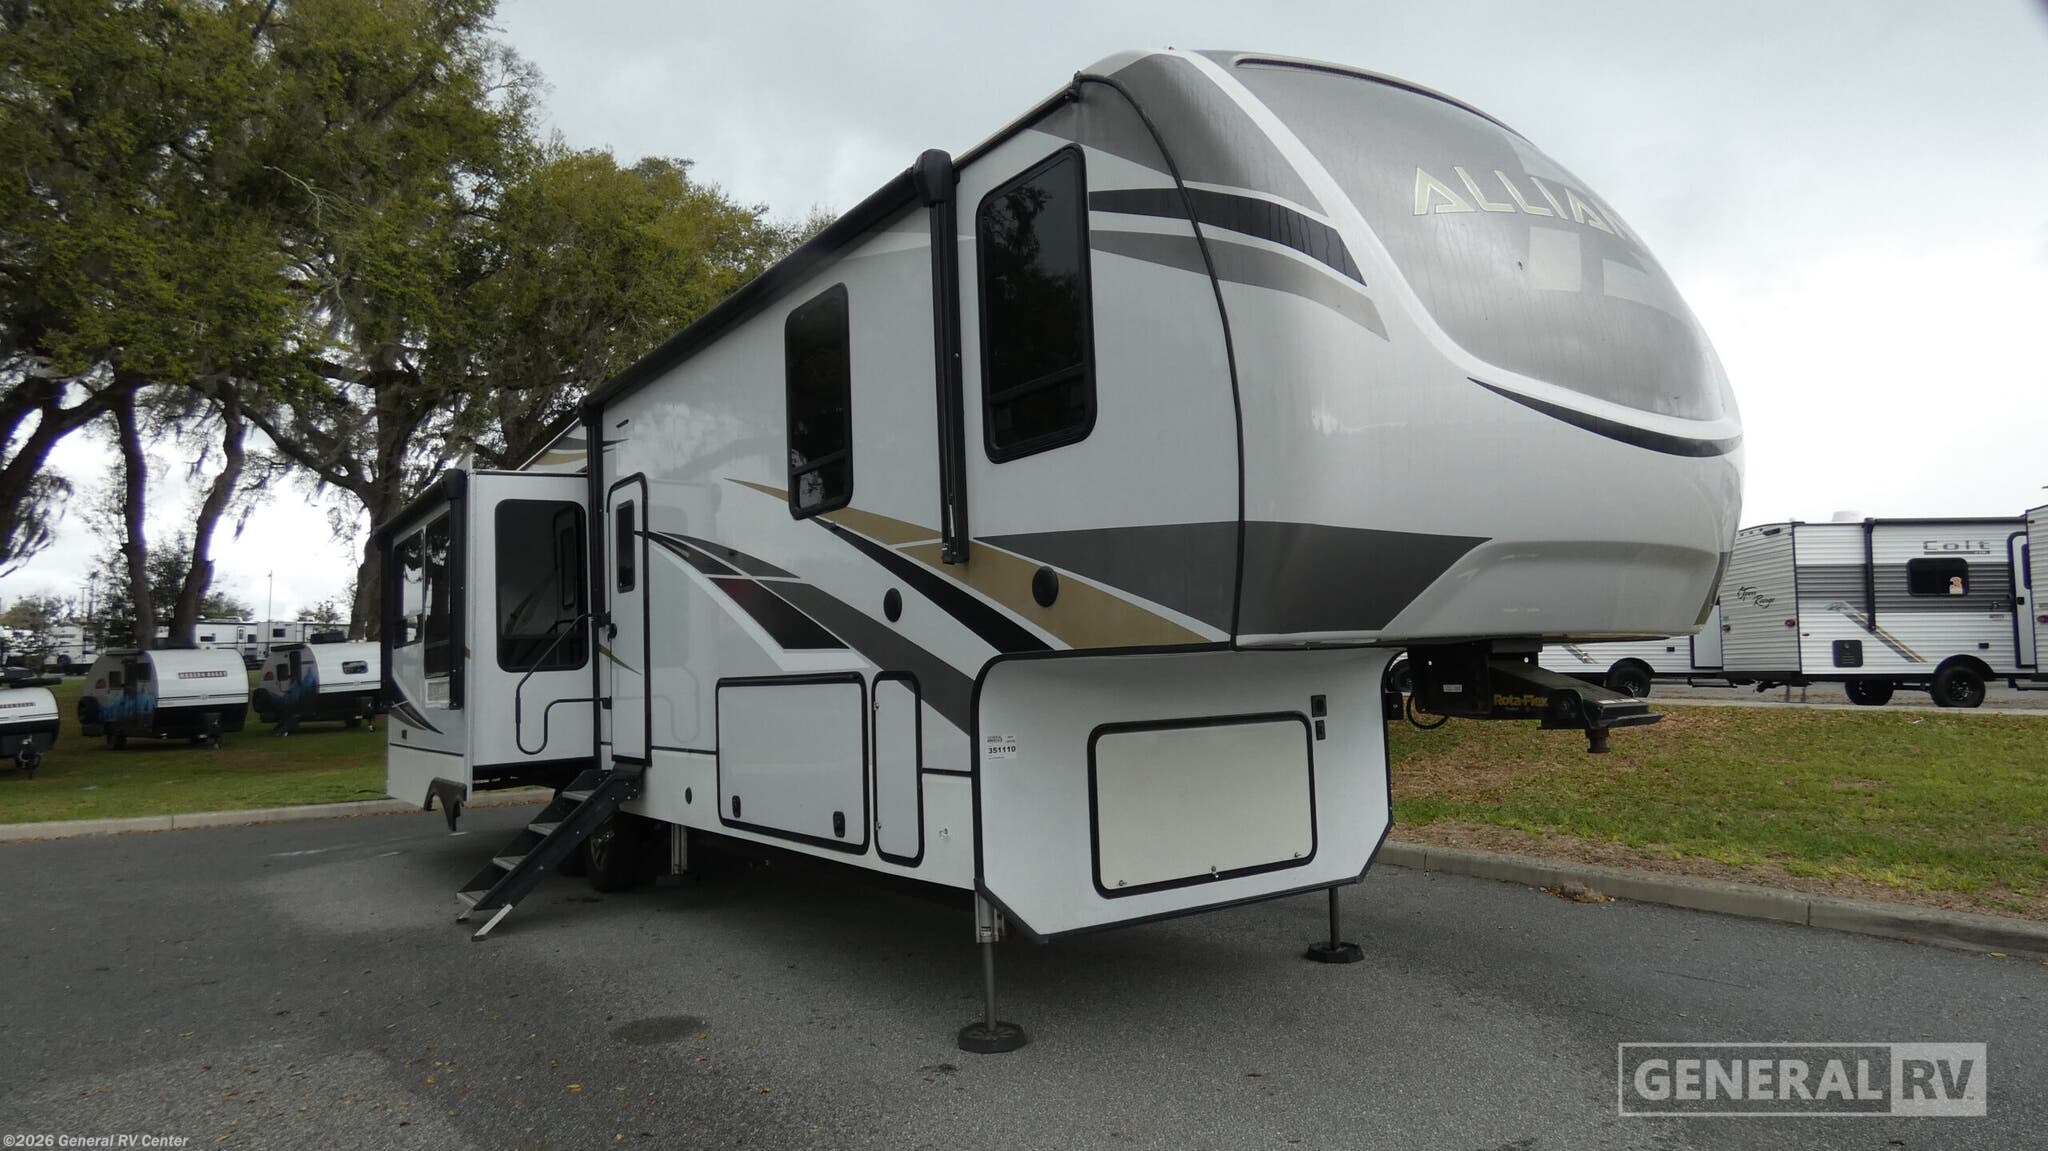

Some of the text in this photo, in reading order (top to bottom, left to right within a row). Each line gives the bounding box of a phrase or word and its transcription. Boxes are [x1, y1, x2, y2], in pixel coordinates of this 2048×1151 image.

[1923, 540, 1991, 551] Colt
[1493, 694, 1549, 707] Rota-Flex
[987, 745, 1017, 754] 351110
